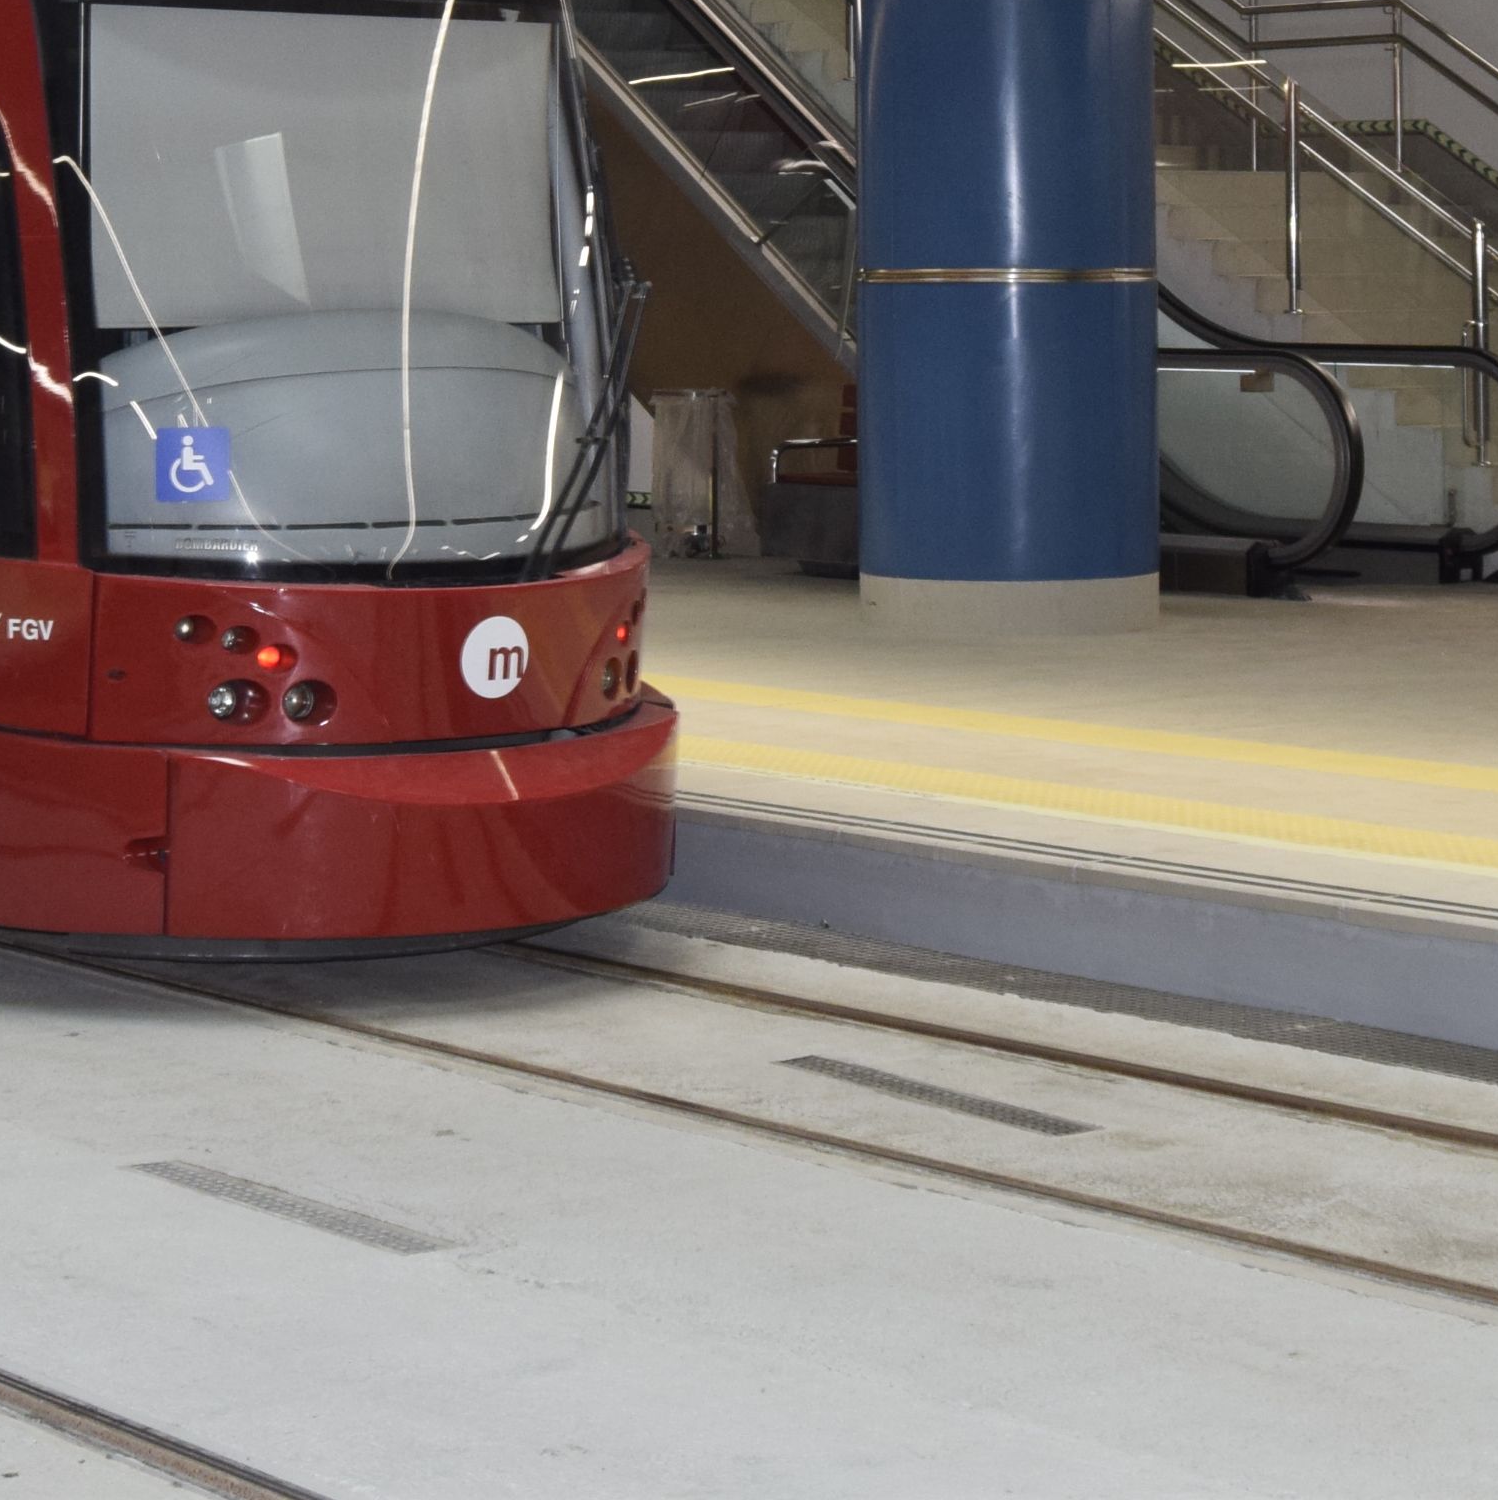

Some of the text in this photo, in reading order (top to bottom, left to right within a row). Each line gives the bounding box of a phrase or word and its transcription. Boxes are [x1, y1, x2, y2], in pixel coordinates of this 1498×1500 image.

[174, 536, 259, 552] BOMBARDIER
[8, 617, 54, 641] FGV
[487, 645, 525, 681] m
